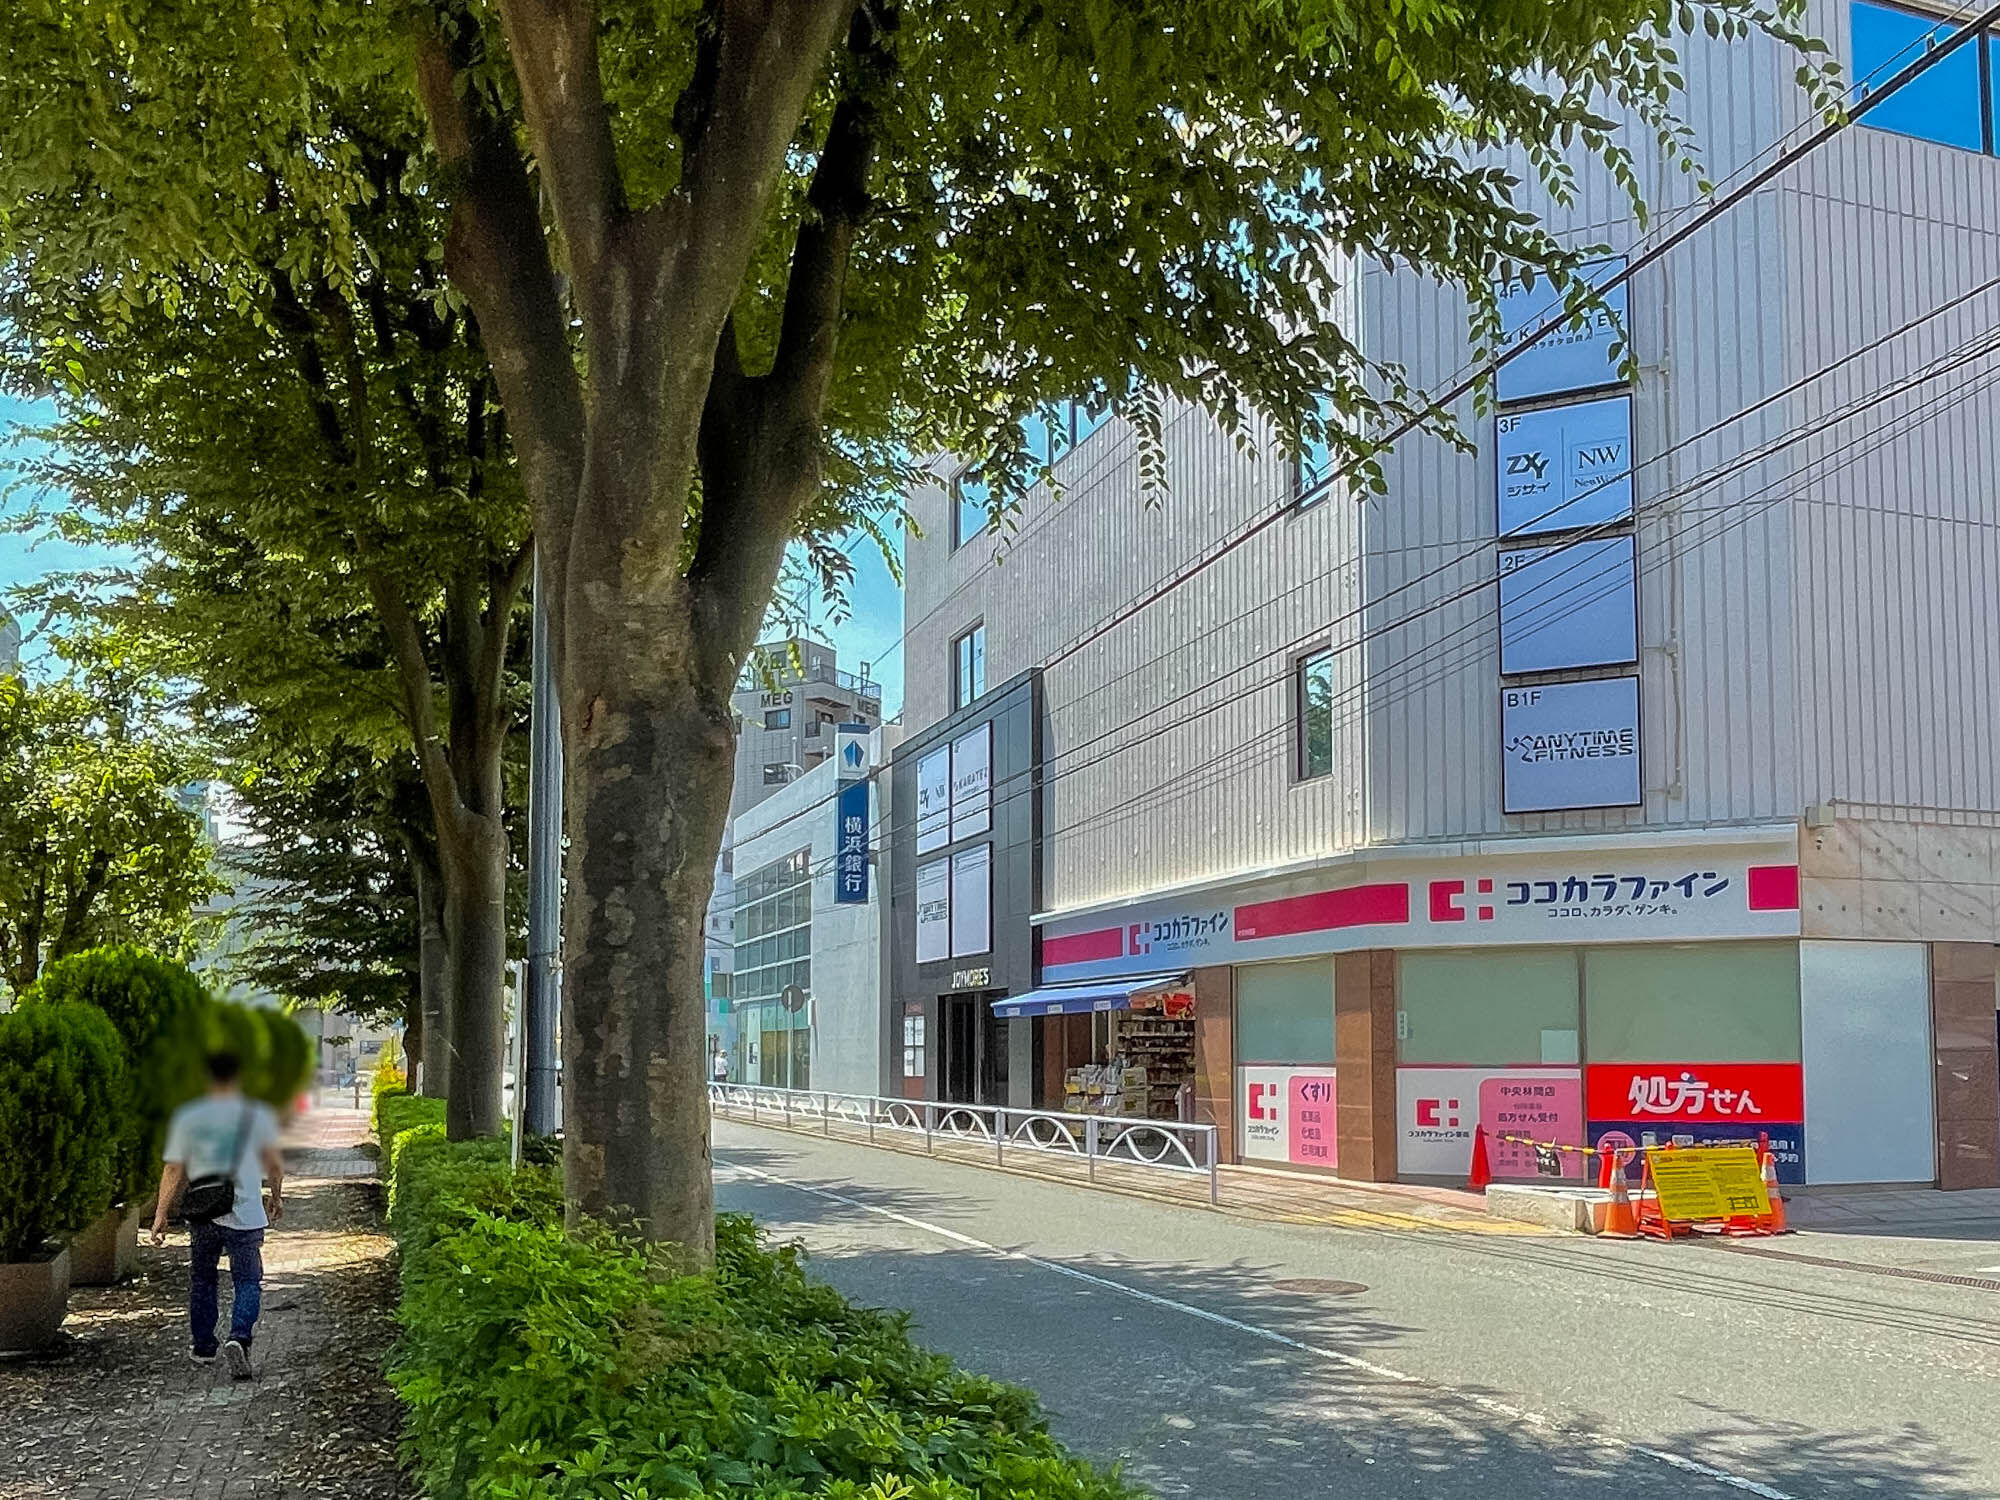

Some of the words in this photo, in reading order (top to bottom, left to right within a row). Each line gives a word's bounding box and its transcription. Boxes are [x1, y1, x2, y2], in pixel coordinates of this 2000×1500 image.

[1499, 417, 1521, 433] 3F
[1506, 452, 1550, 480] ZXY
[1578, 444, 1621, 469] NW
[1504, 555, 1526, 570] 2F
[760, 692, 793, 708] MEG
[1507, 691, 1542, 707] B1F
[1532, 728, 1633, 750] ANYTIME
[1535, 744, 1634, 762] FITNESS
[844, 816, 862, 893] 横浜銀行
[1506, 871, 1730, 906] ココカラファイン
[1547, 904, 1679, 919] ココロ、カラダ、ゲンキ。
[1154, 912, 1228, 942] ココカラファイン
[1301, 1082, 1331, 1102] くすり
[1628, 1074, 1762, 1115] 処方せん
